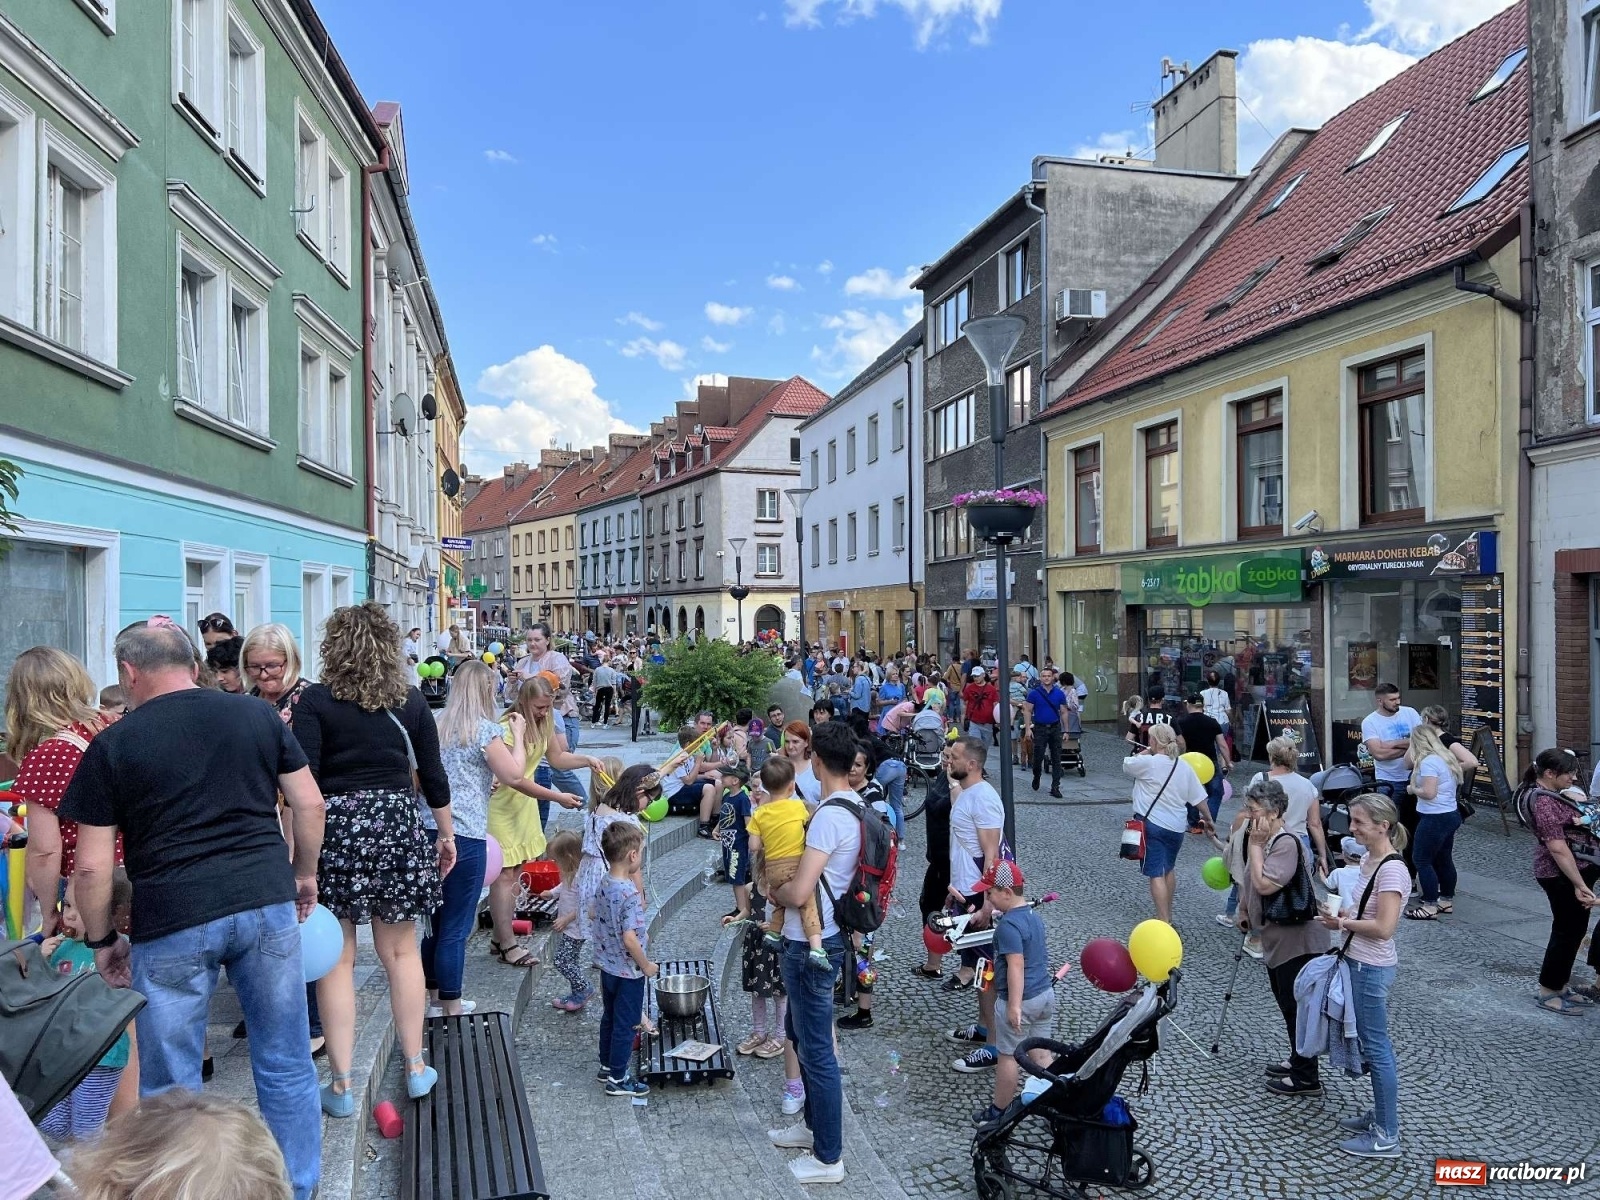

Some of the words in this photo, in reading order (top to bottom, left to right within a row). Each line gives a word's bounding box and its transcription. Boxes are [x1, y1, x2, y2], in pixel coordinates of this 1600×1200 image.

[1334, 549, 1375, 563] MARMARA
[1377, 548, 1408, 560] DONER
[1409, 545, 1441, 558] KEBAB
[1347, 561, 1382, 572] ORYGINALNY
[1382, 560, 1406, 570] TURECKI
[1406, 560, 1424, 568] SMAK
[1176, 565, 1238, 595] żabka
[1247, 567, 1297, 582] żabka
